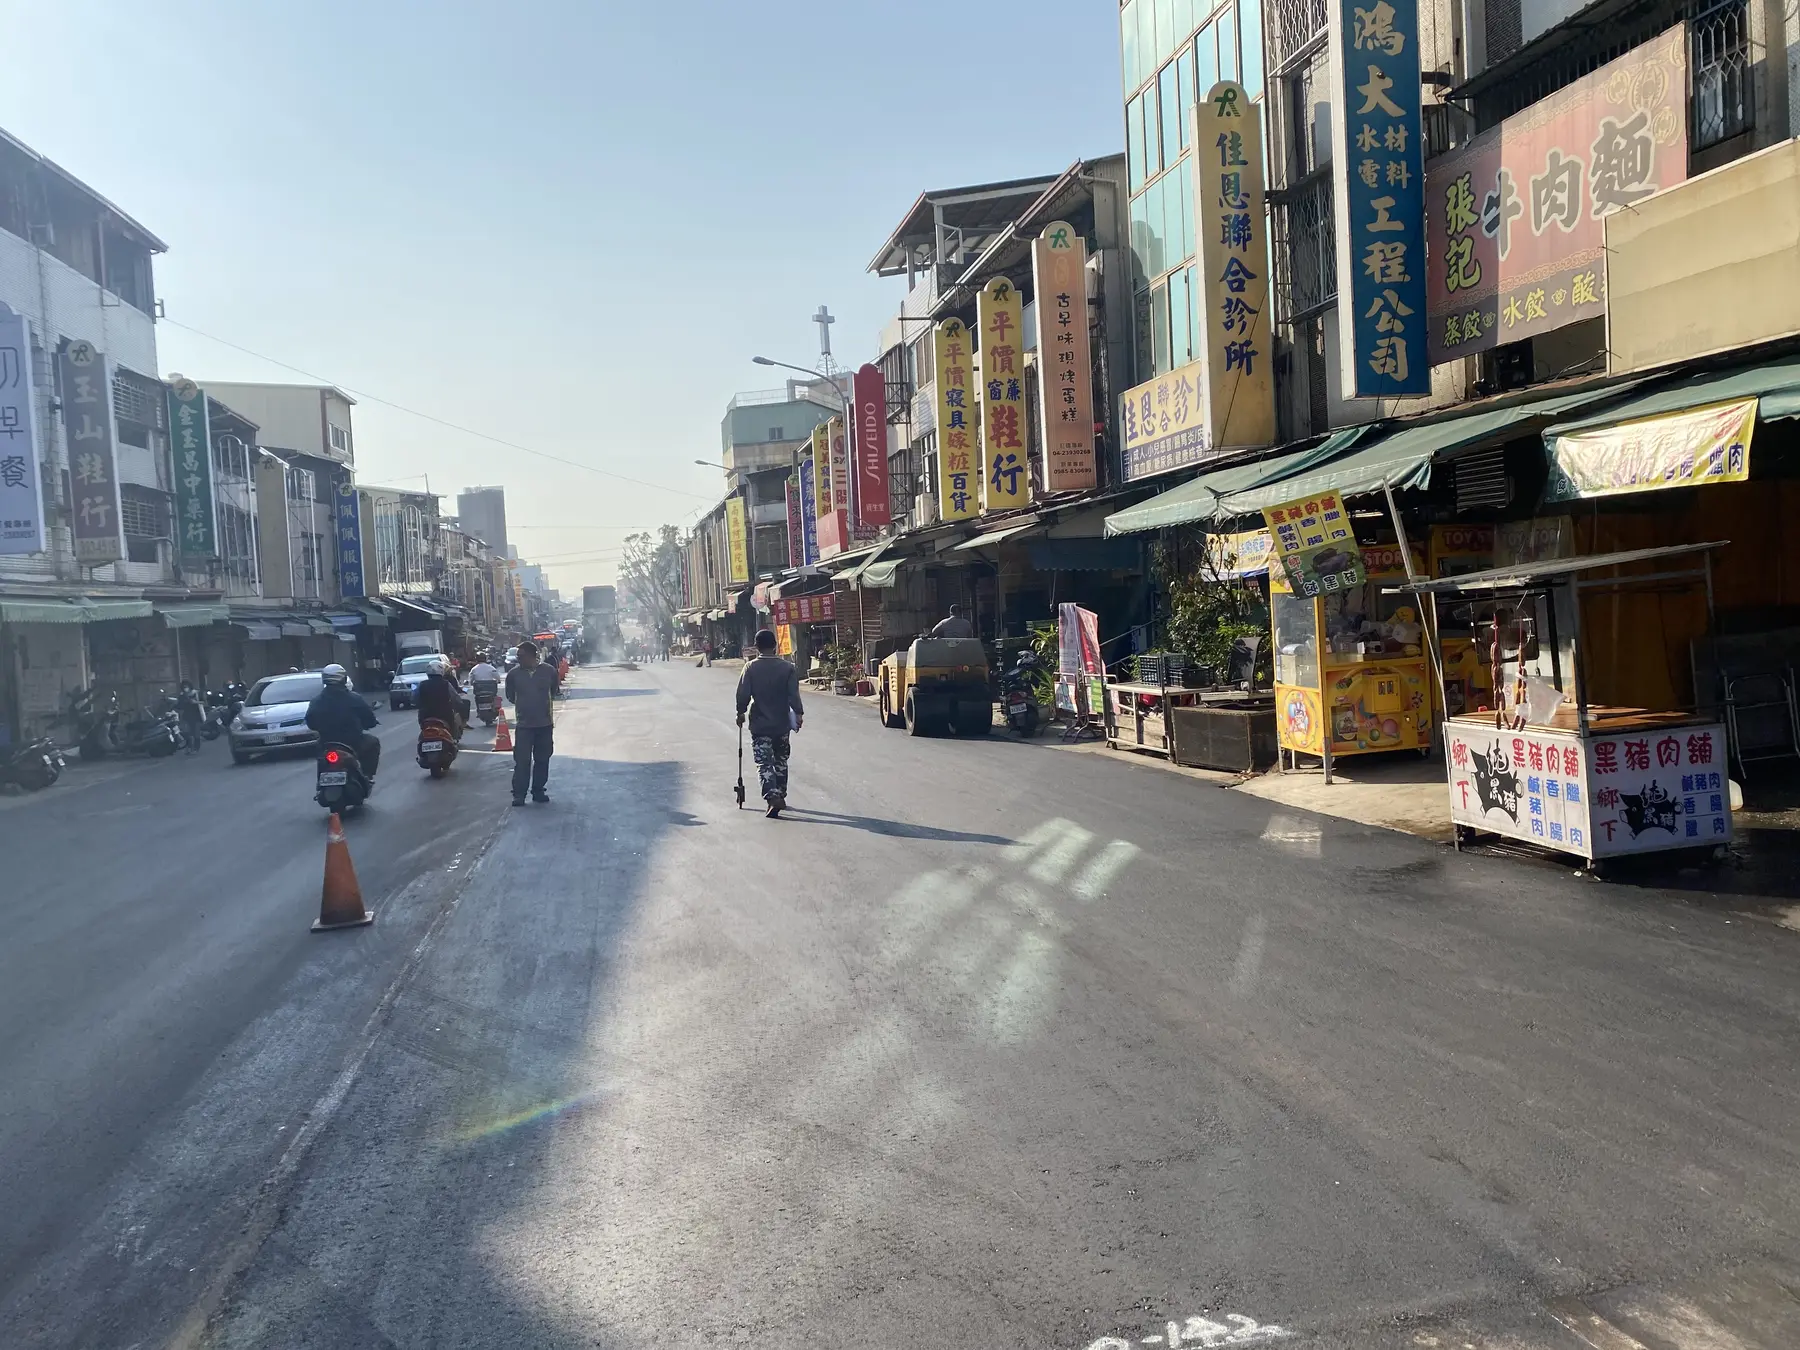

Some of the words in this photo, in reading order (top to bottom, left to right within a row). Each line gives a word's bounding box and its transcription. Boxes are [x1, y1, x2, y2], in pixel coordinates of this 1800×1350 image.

[1215, 132, 1260, 377] 佳恩聯合診所
[1445, 171, 1481, 292] 張記
[1503, 288, 1547, 329] 水餃
[1056, 293, 1078, 422] 古早味現烤蛋糕
[864, 402, 881, 485] SHISEIDO
[866, 503, 885, 512] 資生堂
[1452, 738, 1469, 810] 鄉下
[1597, 786, 1619, 842] 鄉下
